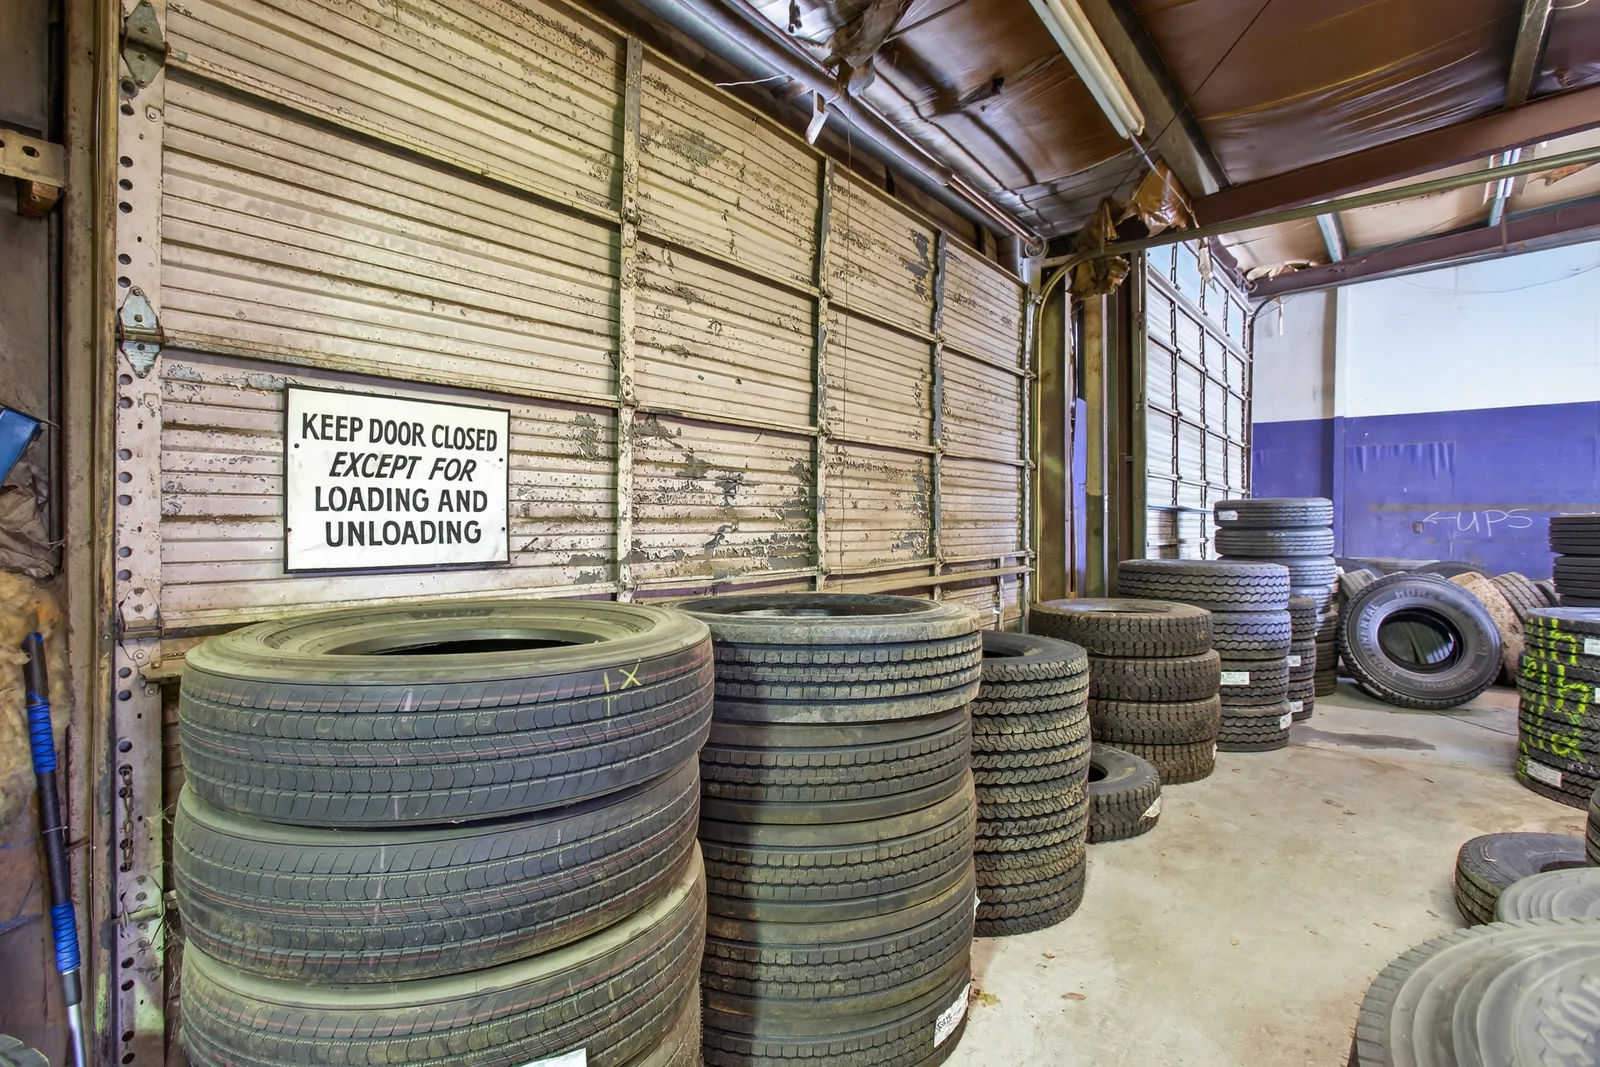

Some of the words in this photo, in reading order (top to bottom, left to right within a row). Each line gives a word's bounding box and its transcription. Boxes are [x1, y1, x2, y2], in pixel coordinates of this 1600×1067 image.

[302, 412, 363, 442] KEEP
[369, 418, 427, 447] DOOR
[432, 424, 497, 452] CLOSED
[329, 452, 422, 480] EXCEPT
[428, 457, 477, 482] FOR
[315, 486, 429, 512] LOADING
[438, 489, 488, 513] AND
[325, 520, 482, 548] UNLOADING
[1456, 508, 1533, 537] UPS
